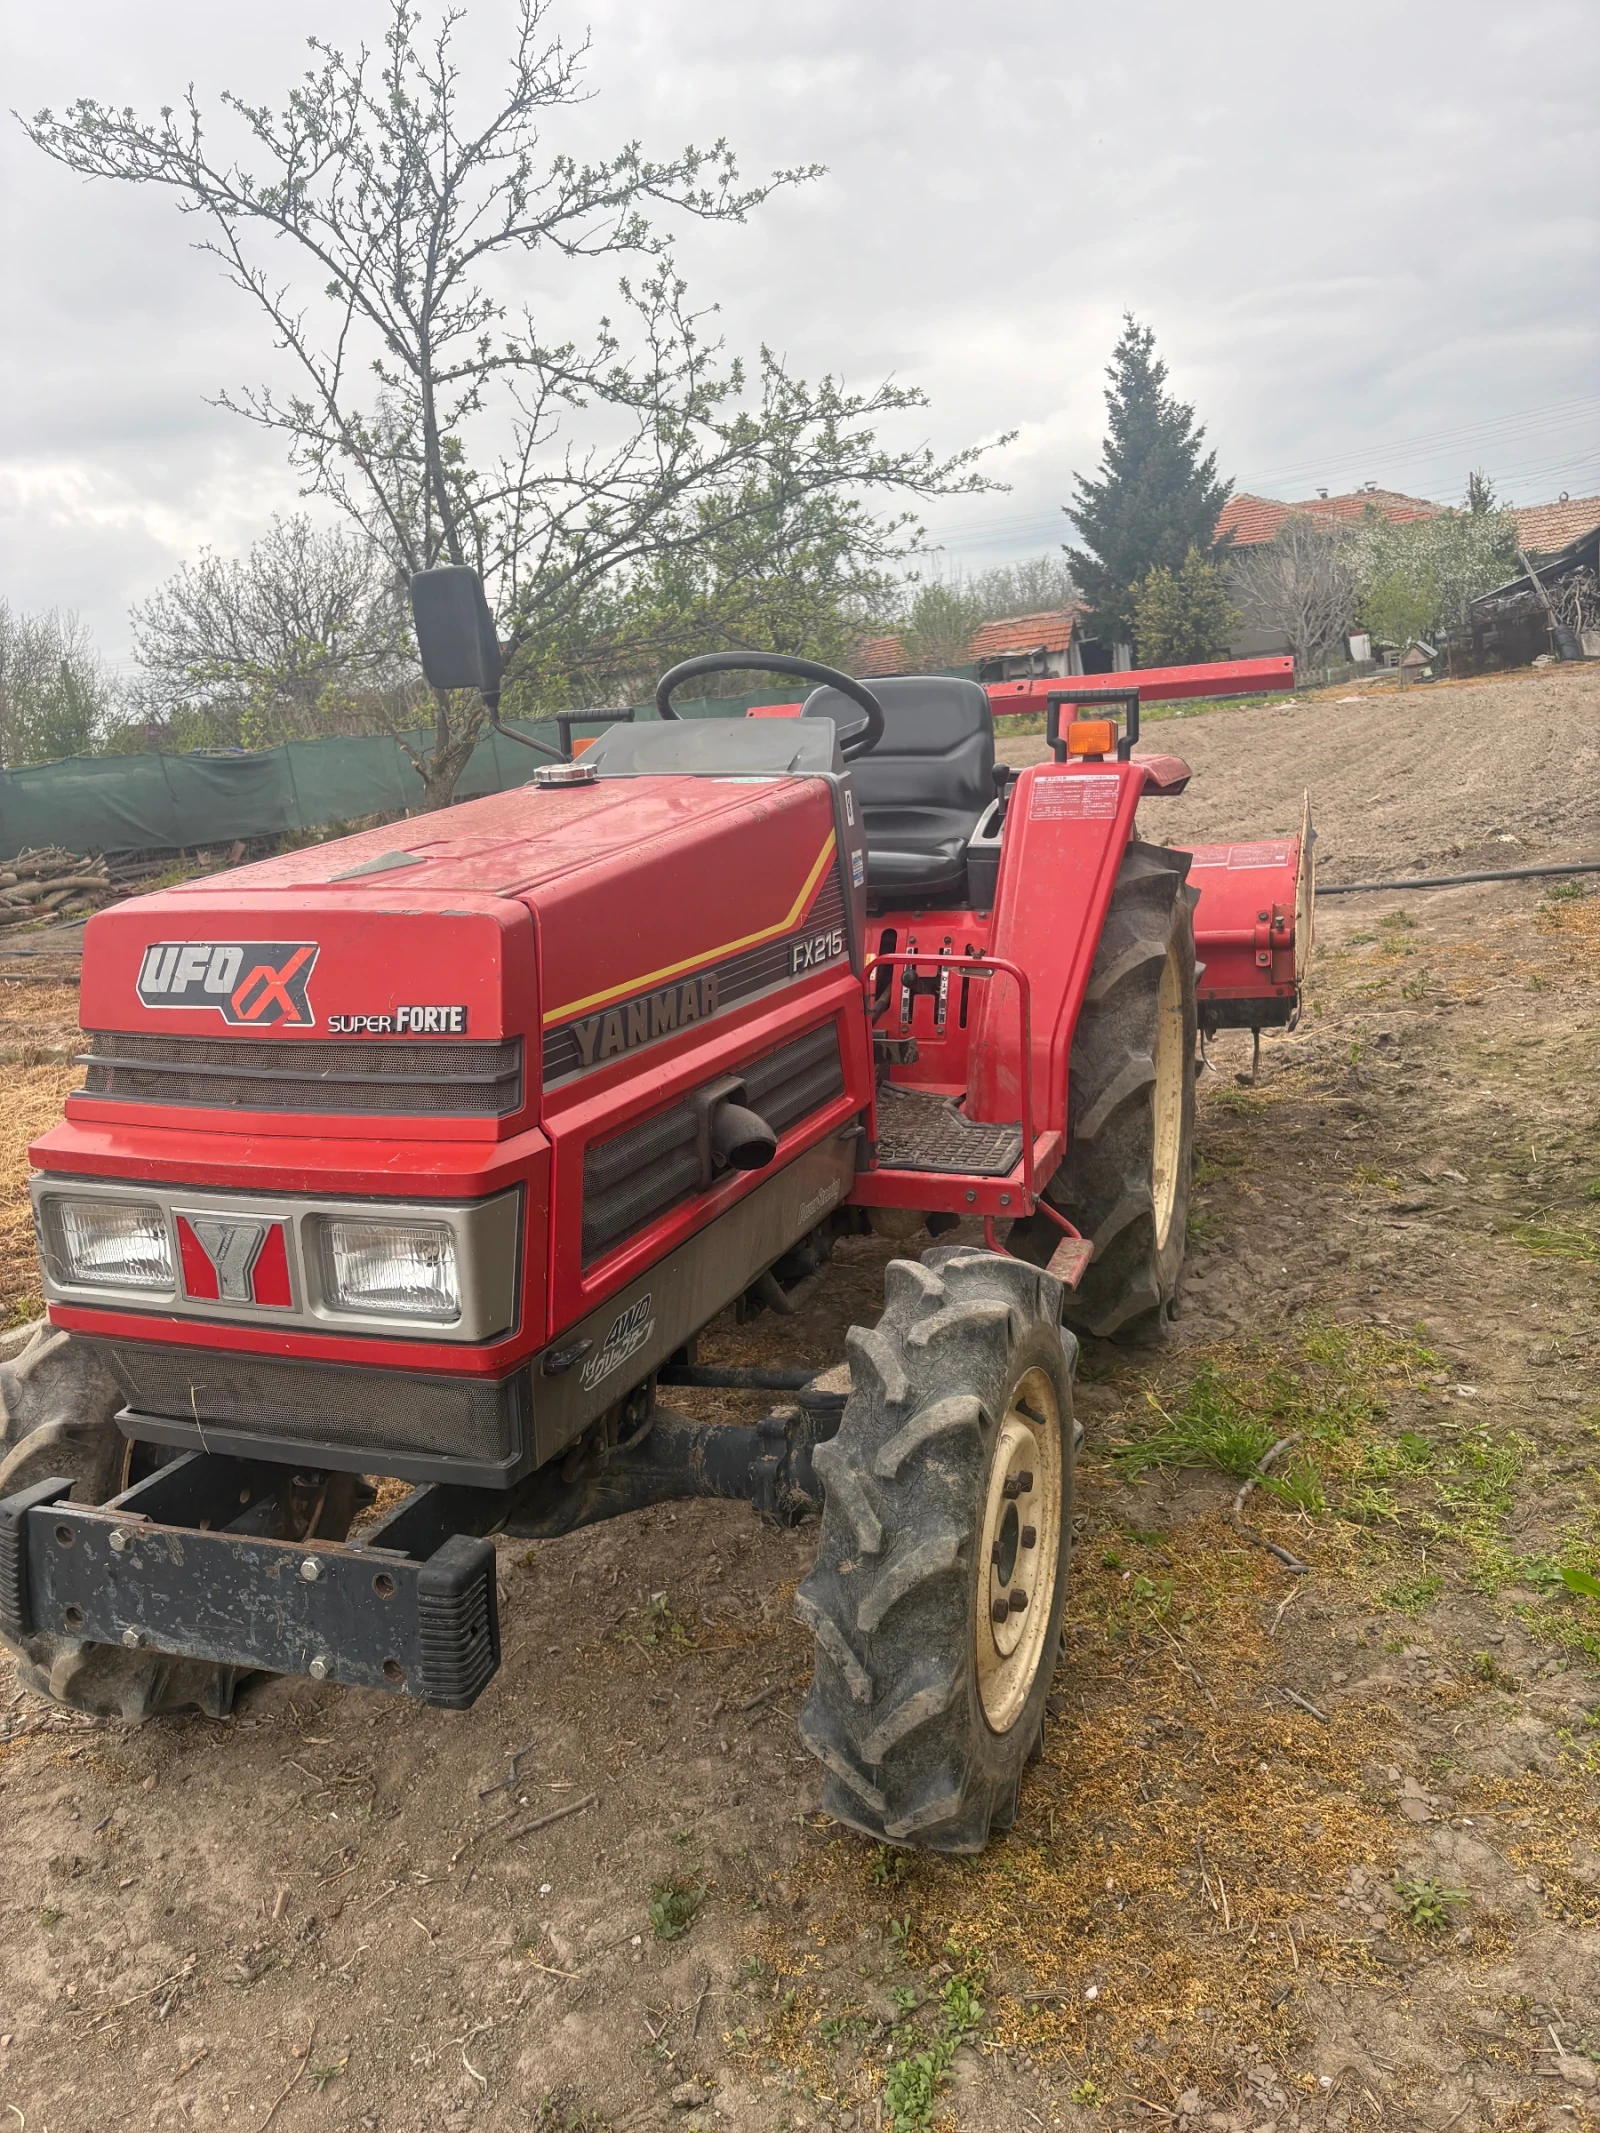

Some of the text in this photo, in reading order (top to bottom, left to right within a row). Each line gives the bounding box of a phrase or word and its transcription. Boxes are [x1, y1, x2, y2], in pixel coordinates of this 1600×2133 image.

[141, 947, 244, 994] UFO
[791, 928, 843, 974] FX215
[327, 1005, 465, 1034] SUPER FORTE
[571, 973, 719, 1067] YANMAR
[603, 1292, 652, 1351] 4WD
